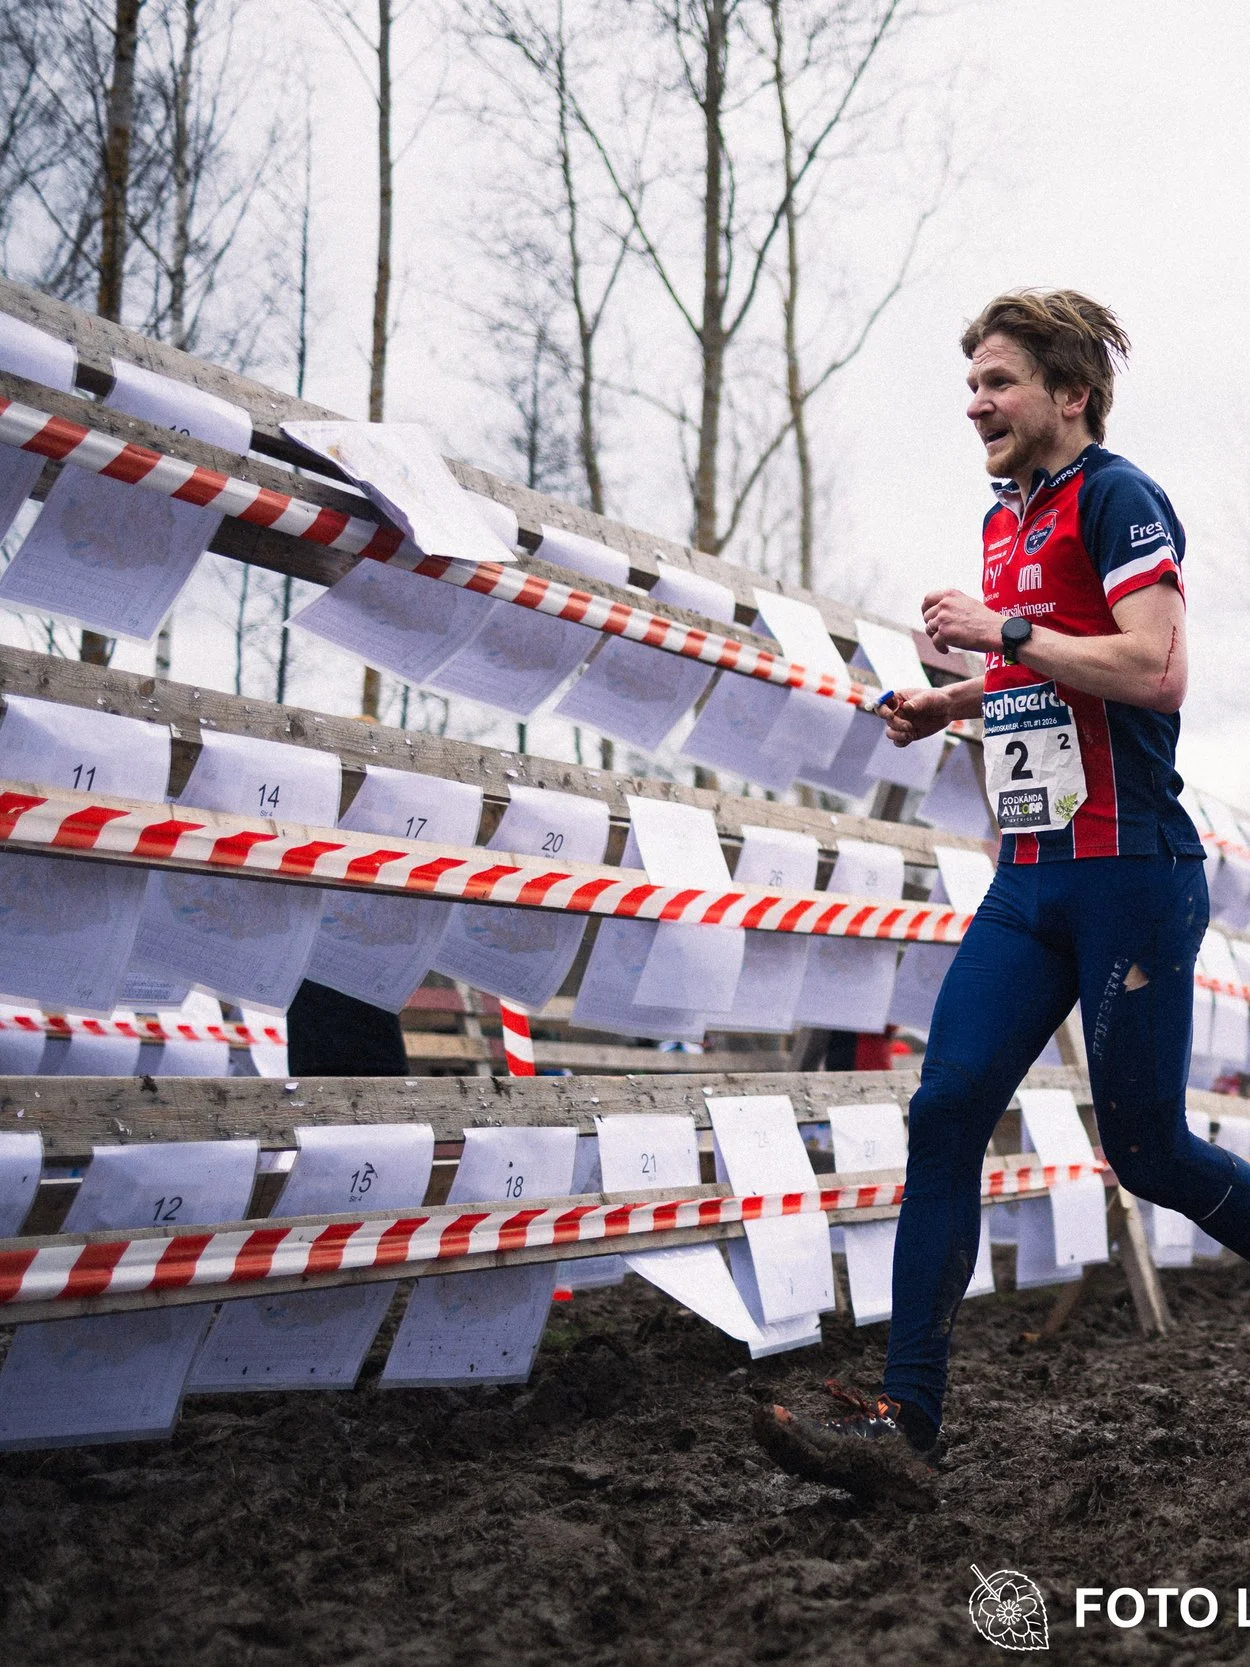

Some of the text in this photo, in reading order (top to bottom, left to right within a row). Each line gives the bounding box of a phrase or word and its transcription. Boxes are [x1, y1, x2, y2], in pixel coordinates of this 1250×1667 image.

[1042, 717, 1058, 726] 2026
[1057, 733, 1072, 750] 2
[1005, 740, 1034, 781] 2
[73, 764, 97, 791] 11
[258, 783, 280, 808] 14
[405, 816, 428, 838] 17
[541, 832, 564, 853] 20
[640, 1153, 657, 1174] 21
[350, 1169, 372, 1193] 15
[505, 1176, 524, 1198] 18
[154, 1195, 183, 1221] 12
